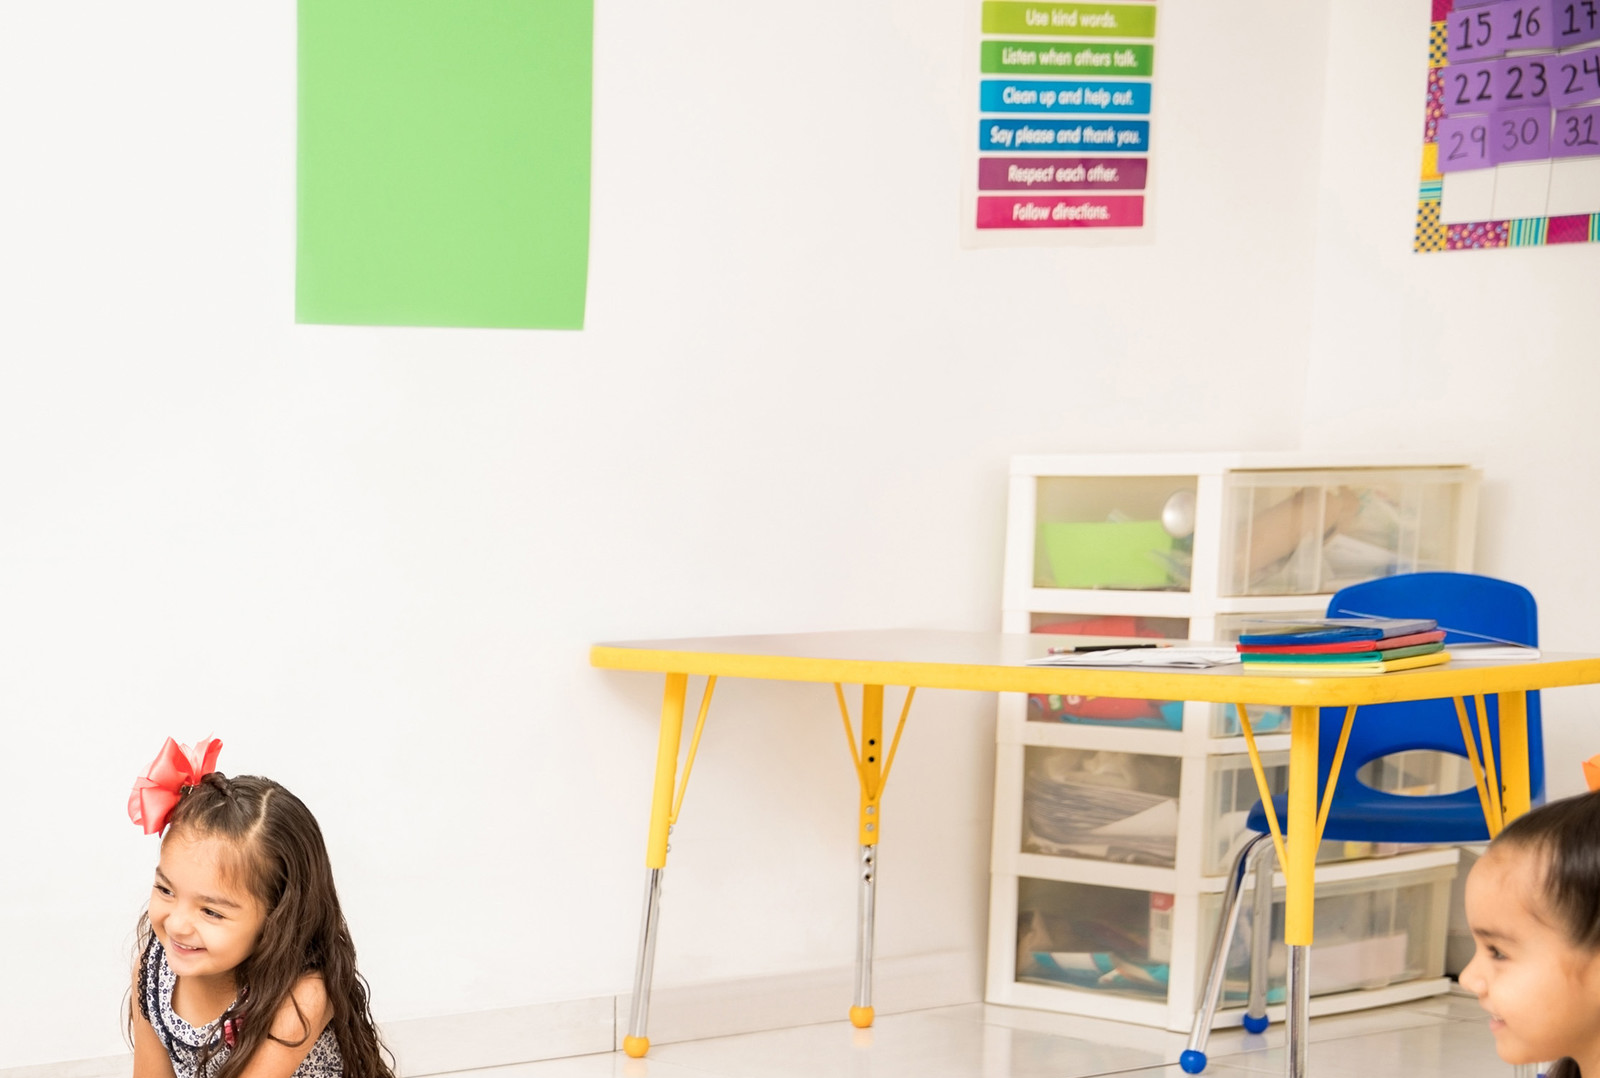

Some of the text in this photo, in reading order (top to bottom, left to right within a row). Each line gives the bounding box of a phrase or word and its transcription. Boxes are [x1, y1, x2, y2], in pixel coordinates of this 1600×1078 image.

[1026, 9, 1118, 28] Use kind words.
[1455, 1, 1598, 50] 15 16 17
[1002, 47, 1139, 67] Listen when others talk.
[1454, 54, 1600, 105] 22 23 24
[1002, 86, 1134, 109] Clean up and help out.
[990, 125, 1141, 148] Say please and thank you.
[1446, 113, 1599, 161] 29 30 31
[1008, 164, 1120, 186] Respect each other.
[1013, 202, 1111, 221] Follow directions.
